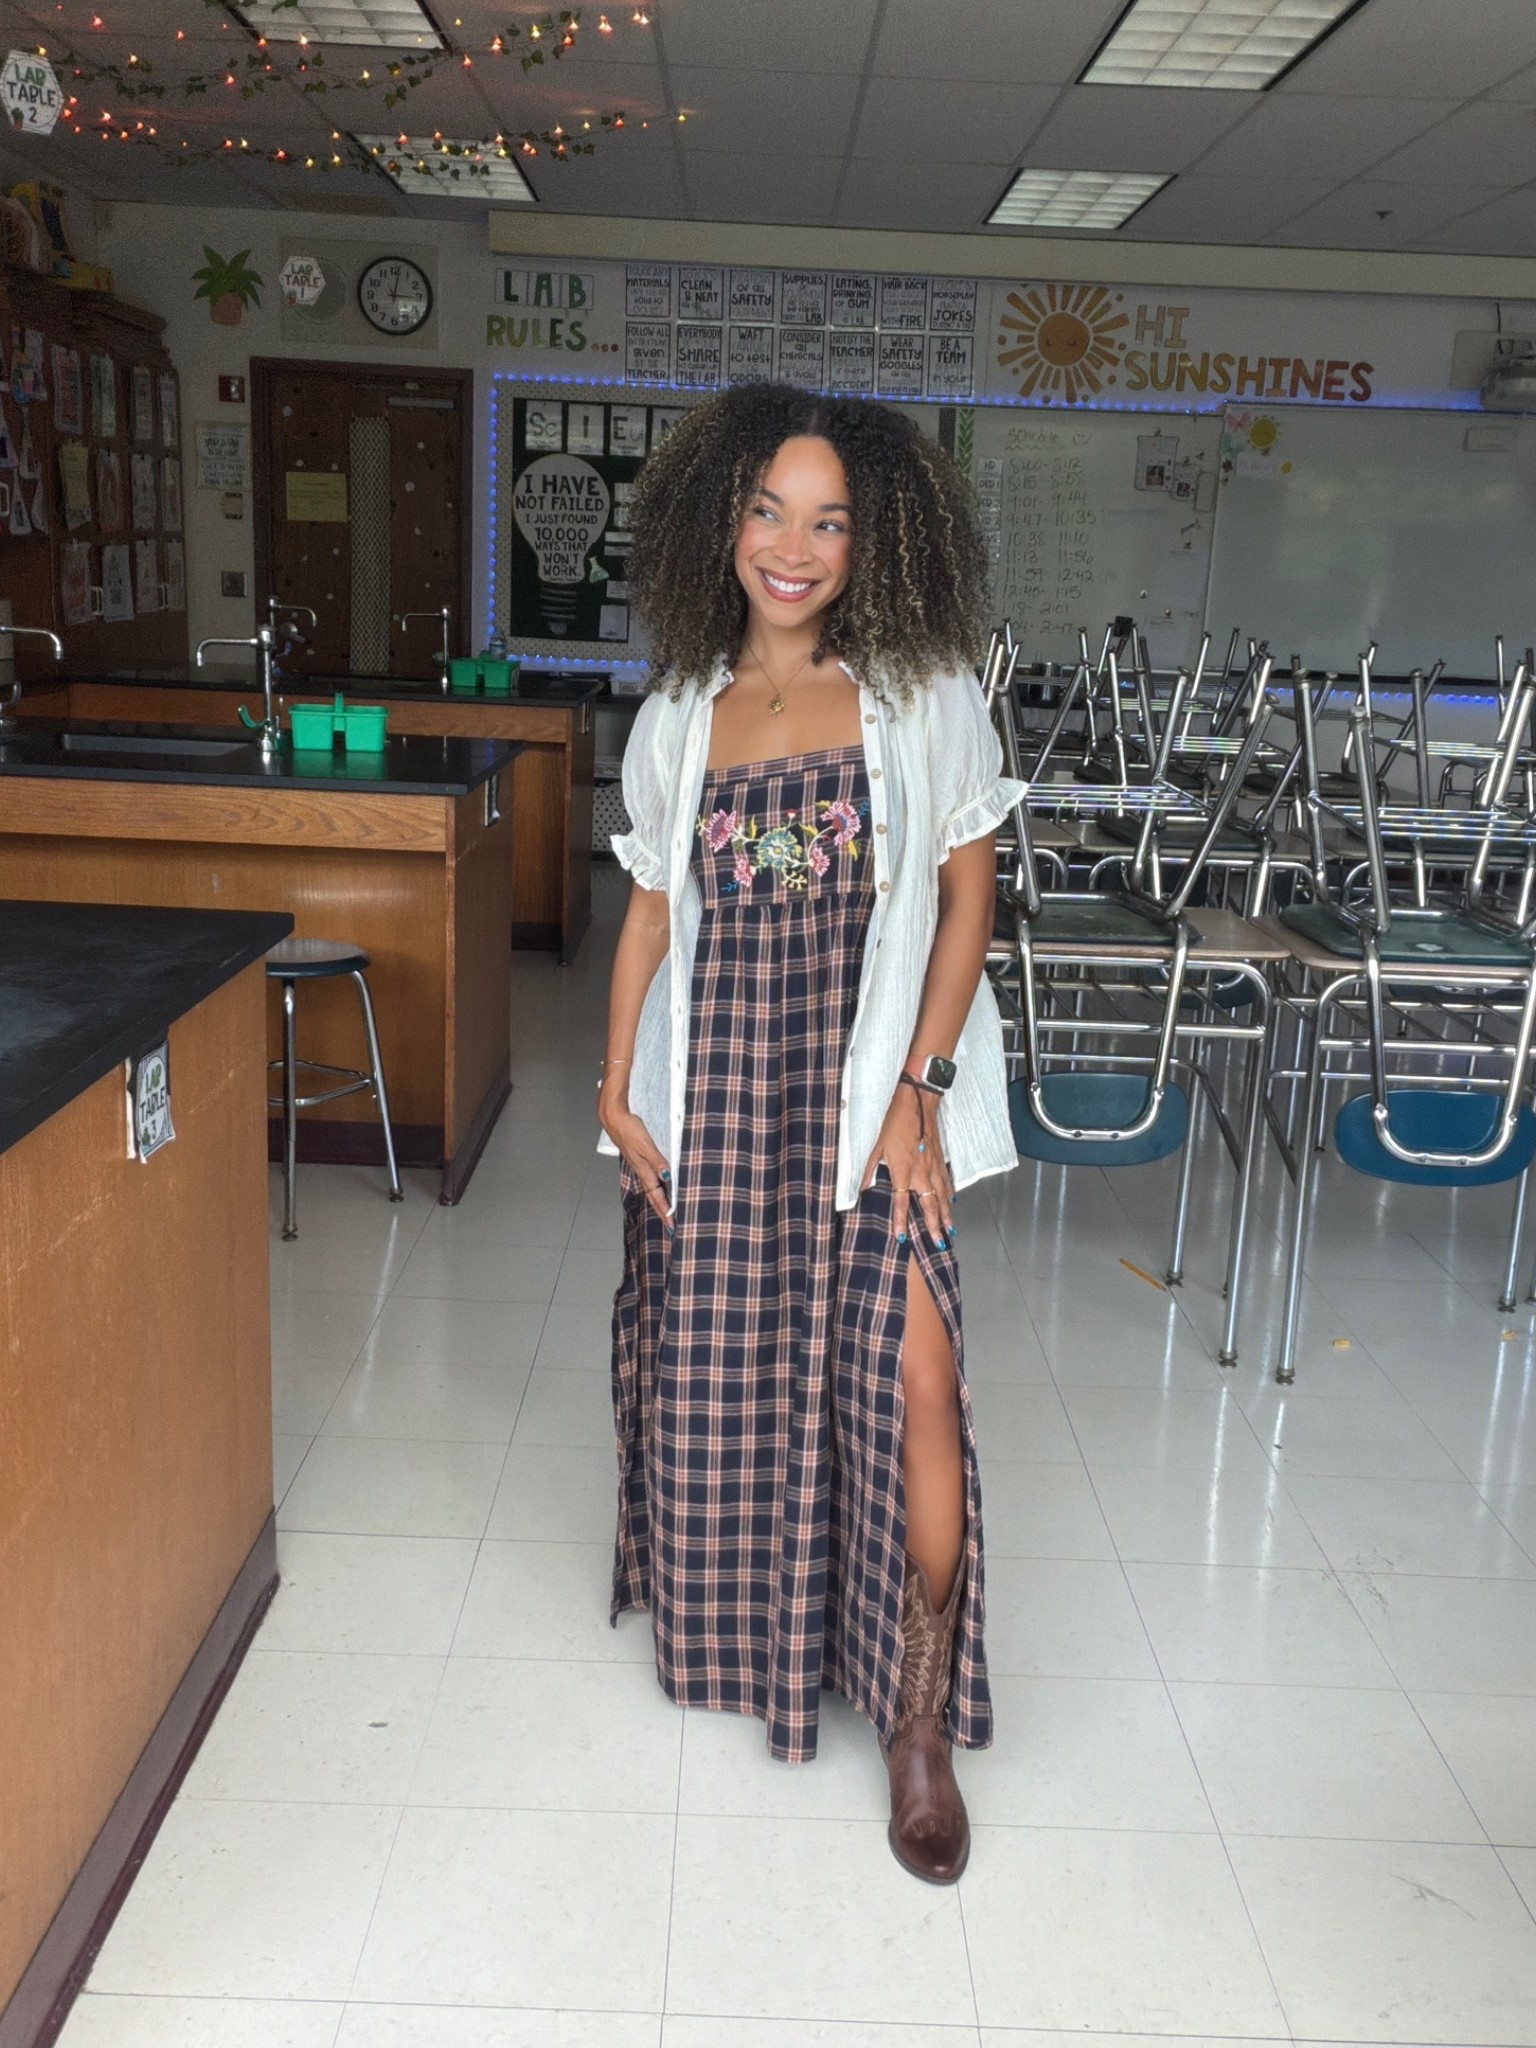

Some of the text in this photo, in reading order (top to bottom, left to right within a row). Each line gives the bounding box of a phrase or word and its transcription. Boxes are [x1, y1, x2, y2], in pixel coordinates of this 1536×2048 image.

[15, 63, 46, 86] LAB
[7, 81, 56, 107] TABLE
[29, 106, 37, 123] 2
[291, 263, 314, 275] LAB
[380, 269, 387, 278] 11
[390, 266, 401, 276] 12
[285, 274, 320, 288] TABLE
[370, 279, 380, 287] 10
[412, 281, 419, 290] 2
[628, 278, 670, 288] MATERIALS
[681, 280, 713, 290] CLEAN
[301, 288, 304, 298] 1
[367, 290, 374, 299] 9
[504, 271, 587, 309] LAB
[416, 293, 423, 302] 3
[695, 292, 719, 303] NEAT
[731, 294, 772, 306] SAFETY
[371, 303, 378, 312] 8
[847, 299, 869, 309] GUM
[379, 312, 386, 321] 7
[391, 317, 398, 326] 6
[805, 312, 823, 323] LAB
[899, 314, 922, 327] FIRE
[933, 310, 973, 322] JOKES
[627, 326, 670, 337] FOLLOW ALL
[1135, 304, 1191, 349] HI
[679, 327, 721, 339] EVERYBODY
[738, 327, 764, 341] WAFT
[783, 331, 822, 343] CONSIDER
[891, 337, 914, 348] WEAR
[940, 338, 960, 351] BE A
[633, 347, 665, 358] given
[679, 348, 720, 363] SHARE
[831, 346, 875, 357] TEACHER
[881, 348, 923, 361] SAFETY
[936, 351, 967, 364] TEAM
[880, 361, 923, 371] GOGGLES
[627, 369, 667, 380] TEACHER
[1124, 350, 1375, 402] SUNSHINES
[524, 474, 600, 496] I HAVE
[515, 495, 545, 510] NOT
[534, 514, 558, 524] JUST
[561, 514, 598, 525] FOUND
[1055, 510, 1097, 526] 10:35
[534, 527, 589, 543] 10,000
[535, 541, 588, 551] WAYS THAT
[544, 553, 580, 564] WON'T
[145, 1063, 162, 1094] LAB
[140, 1086, 165, 1123] TABLE
[151, 1119, 157, 1140] 3
